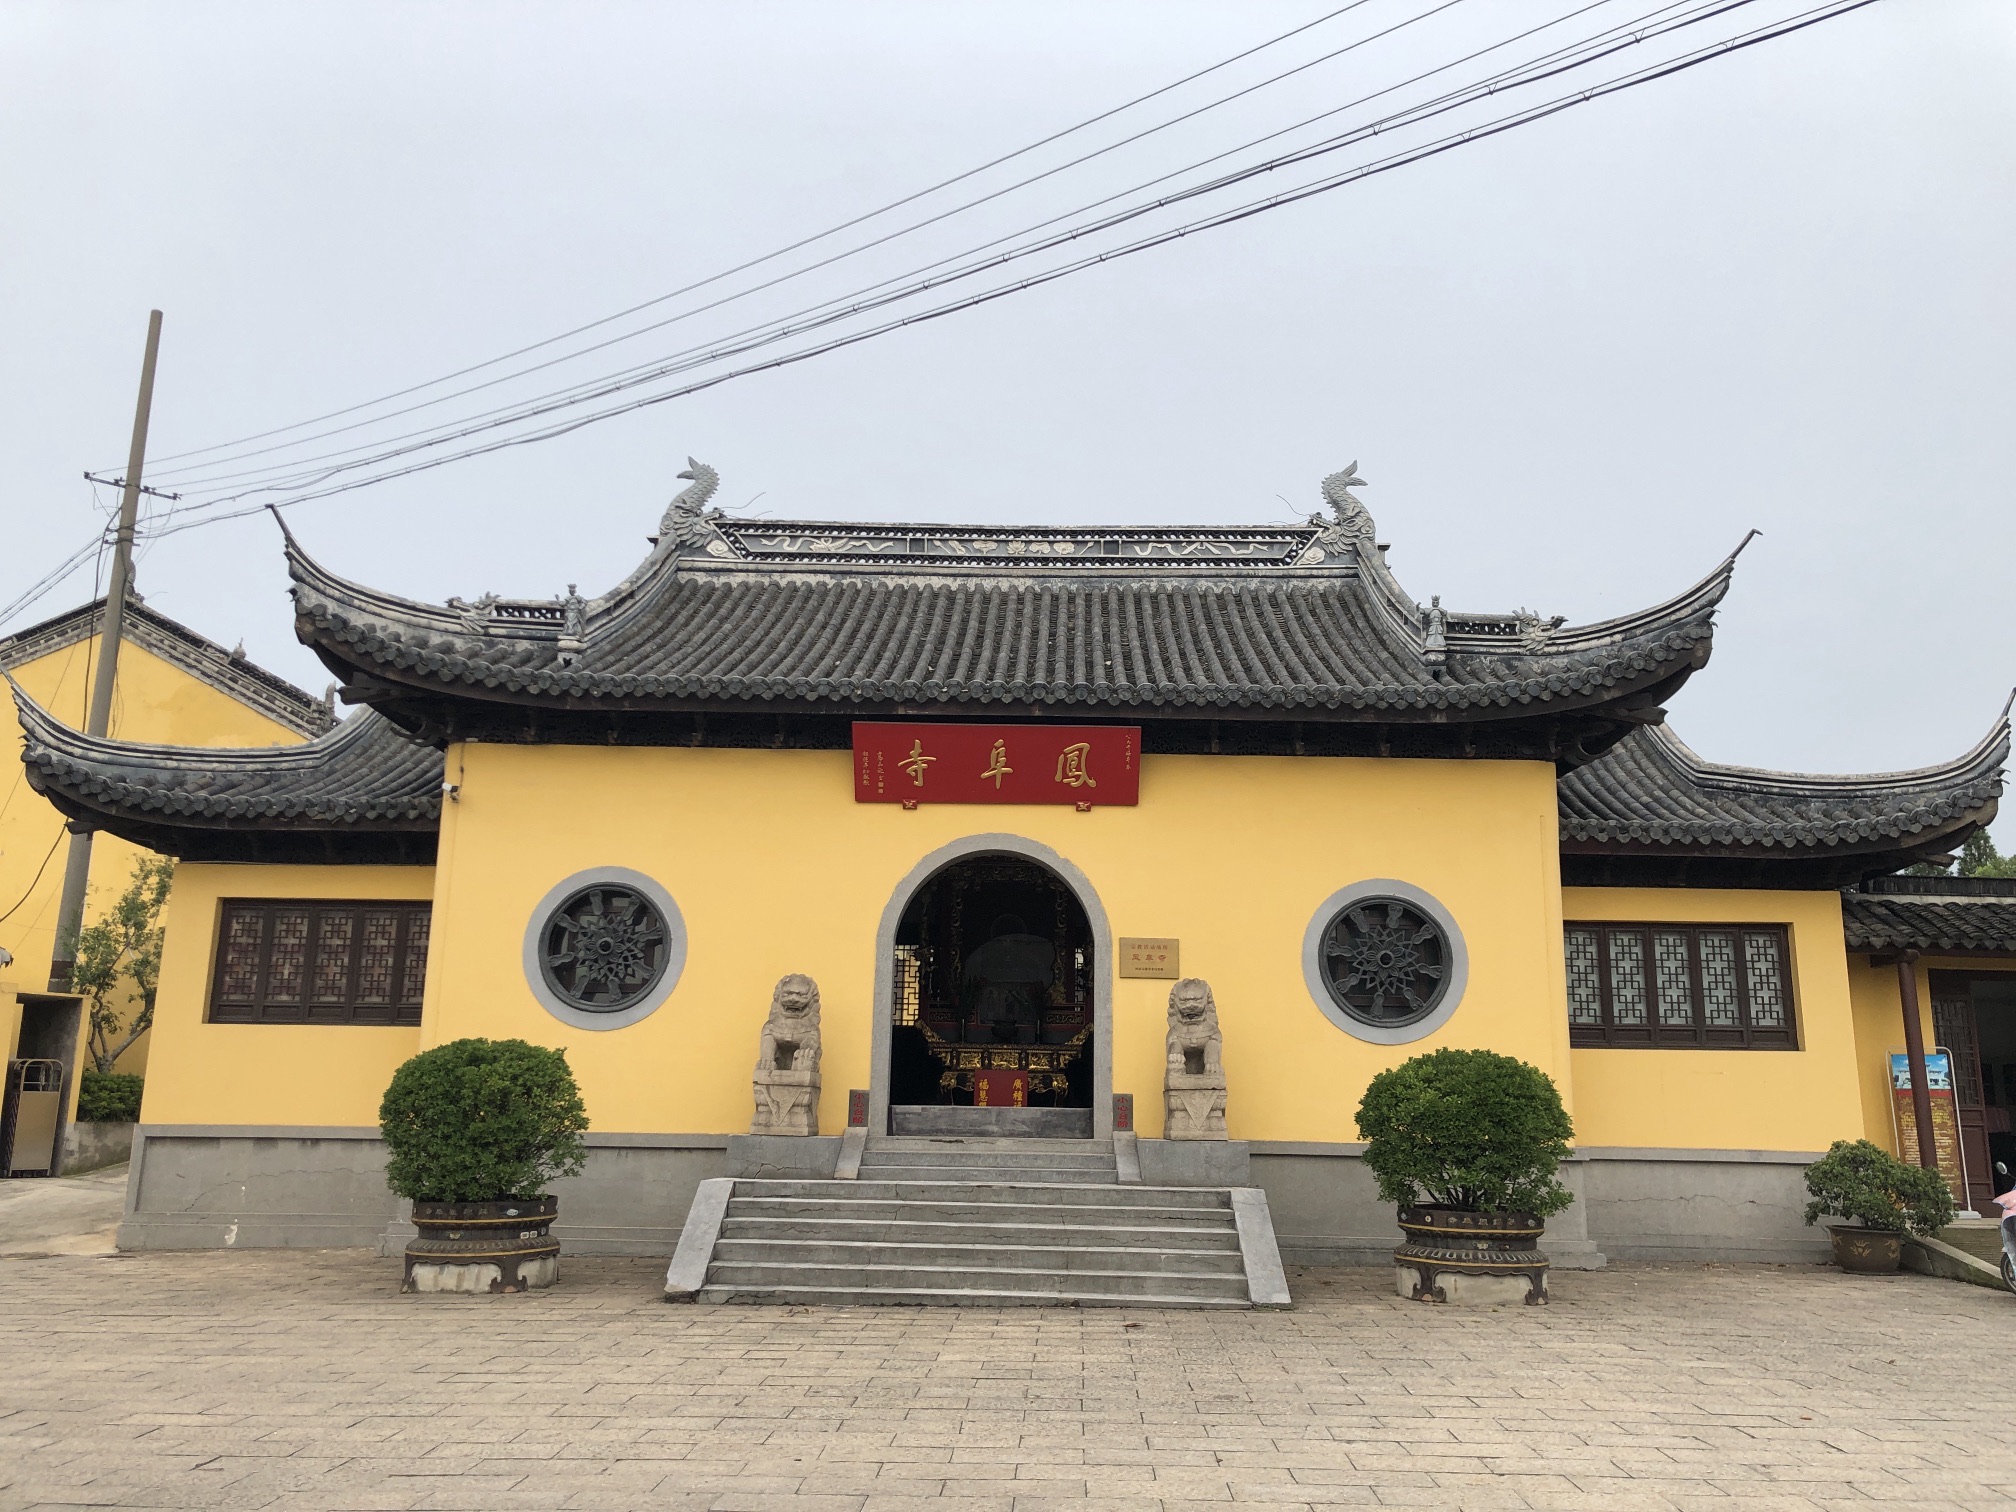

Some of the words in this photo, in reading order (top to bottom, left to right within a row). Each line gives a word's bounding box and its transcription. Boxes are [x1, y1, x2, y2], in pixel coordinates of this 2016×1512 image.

[853, 1092, 864, 1124] 小心台阶
[1117, 1096, 1128, 1126] 小心台阶
